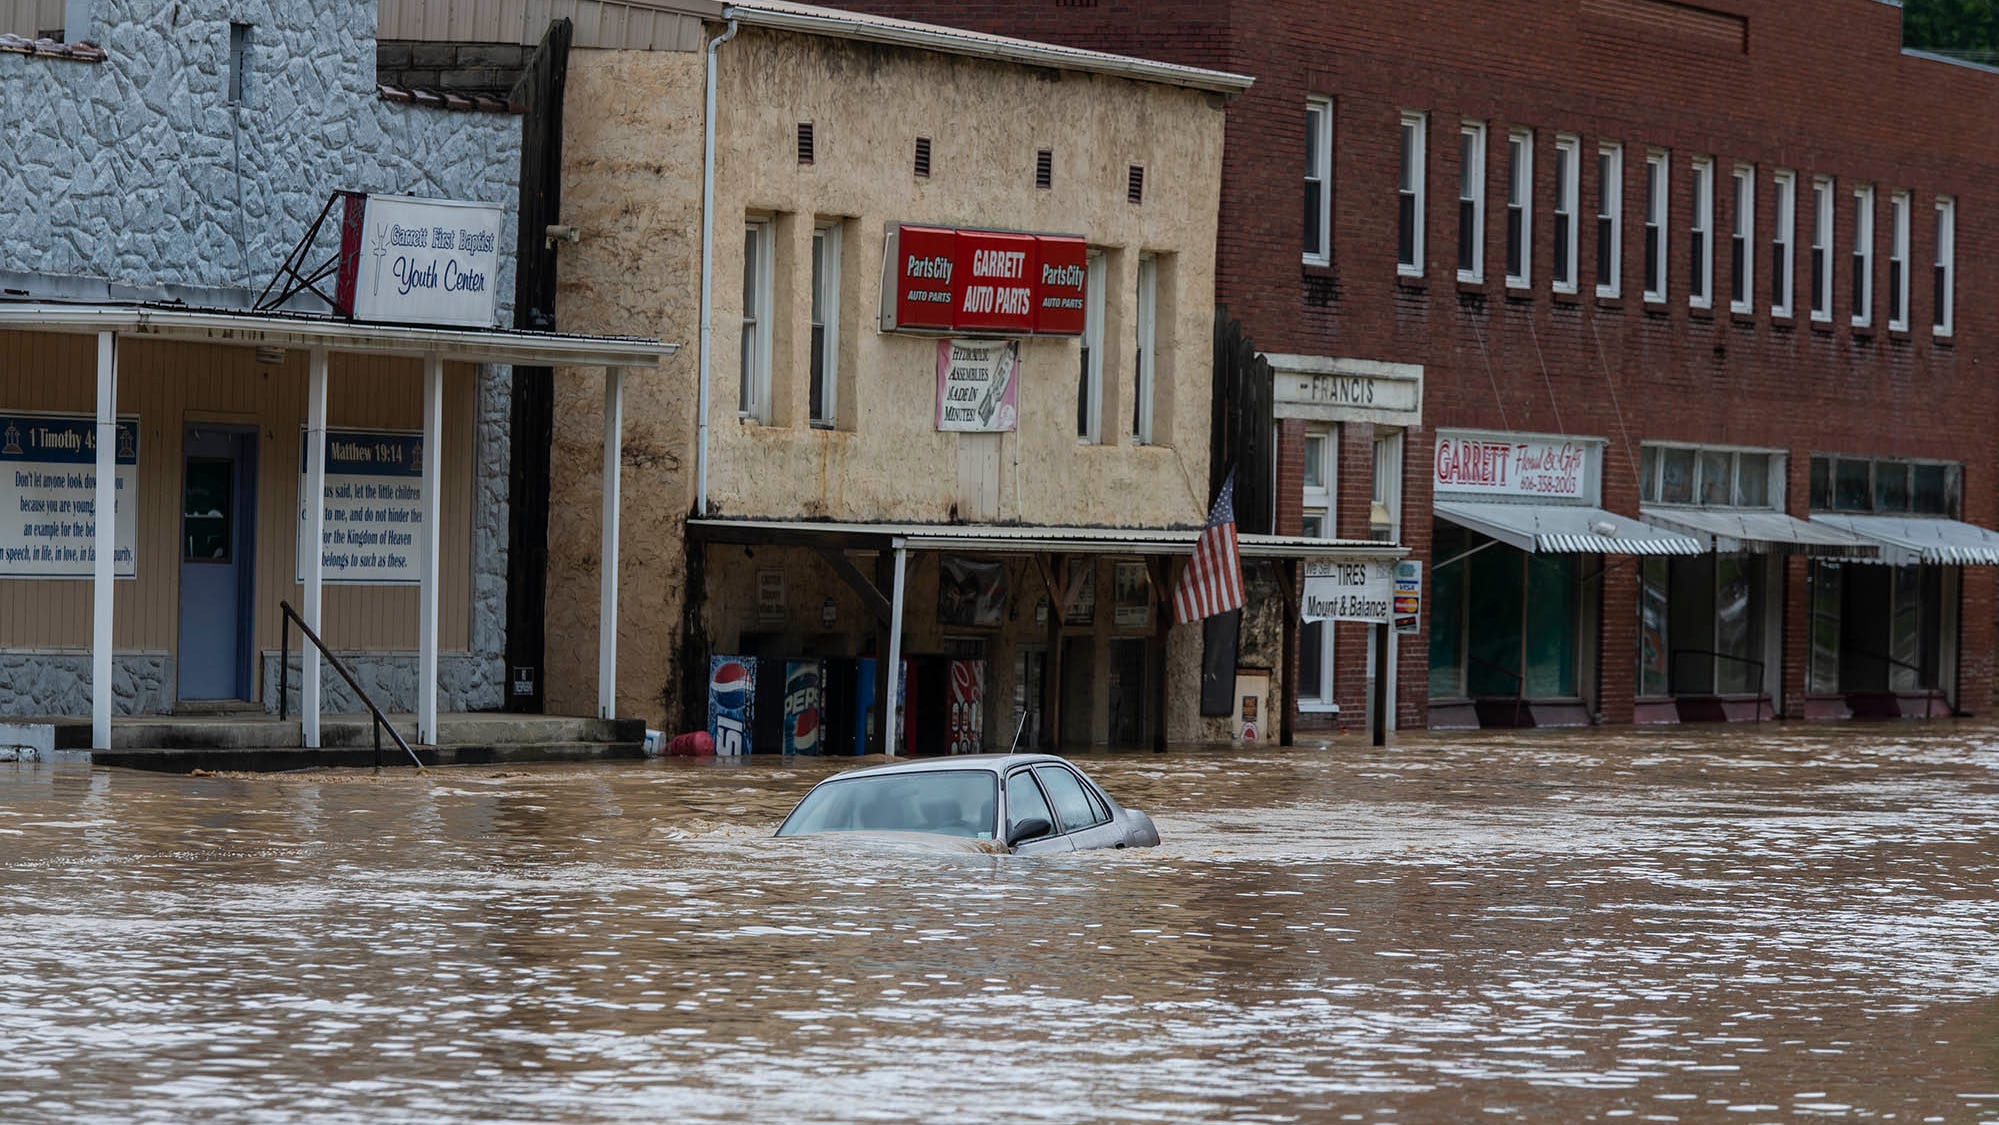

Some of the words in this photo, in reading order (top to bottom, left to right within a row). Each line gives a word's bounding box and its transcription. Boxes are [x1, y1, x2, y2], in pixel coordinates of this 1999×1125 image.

[391, 224, 428, 248] Garrett
[432, 228, 455, 249] First
[459, 229, 495, 256] Baptist
[972, 249, 1026, 279] GARRETT
[393, 256, 438, 295] Youth
[444, 259, 485, 292] Center
[907, 290, 927, 302] AUTO
[928, 292, 952, 304] PARTS
[963, 286, 994, 314] AUTO
[994, 287, 1031, 315] PARTS
[1042, 297, 1061, 308] AUTO
[1061, 298, 1083, 310] PARTS
[948, 366, 989, 381] ASSEMBLIES
[947, 386, 968, 401] MADE
[1312, 376, 1374, 404] FRANCIS
[30, 427, 36, 447] 1
[40, 428, 81, 453] Timothy
[85, 434, 97, 449] 4:
[331, 442, 371, 462] Matthew
[375, 443, 402, 463] 19:14
[1437, 438, 1511, 486] GARRETT
[15, 471, 33, 487] Don't
[34, 472, 42, 488] let
[43, 475, 65, 492] anyone
[67, 473, 82, 489] look
[85, 473, 97, 489] dow
[115, 477, 124, 489] ou
[354, 484, 364, 499] let
[365, 484, 376, 499] the
[378, 484, 393, 500] little
[395, 484, 420, 501] children
[20, 496, 45, 513] because
[47, 499, 57, 515] you
[59, 500, 71, 513] are
[325, 508, 332, 522] to
[334, 509, 347, 524] me,
[350, 507, 363, 522] and
[365, 507, 374, 522] do
[375, 508, 387, 523] not
[388, 507, 410, 523] hinder
[24, 524, 33, 537] an
[34, 522, 60, 540] example
[61, 521, 71, 537] for
[73, 521, 84, 537] the
[333, 529, 345, 544] the
[347, 529, 378, 548] Kingdom
[379, 530, 387, 544] of
[388, 530, 412, 546] Heaven
[5, 544, 31, 564] speech,
[33, 544, 40, 561] in
[55, 545, 62, 561] in
[80, 545, 87, 561] in
[322, 551, 349, 570] belongs
[351, 553, 359, 567] to
[359, 553, 376, 568] such
[378, 556, 386, 568] as
[387, 553, 408, 568] these.
[1337, 563, 1366, 586] TIRES
[1307, 595, 1338, 617] Mount
[1339, 594, 1347, 616] &
[1350, 595, 1387, 617] Balance
